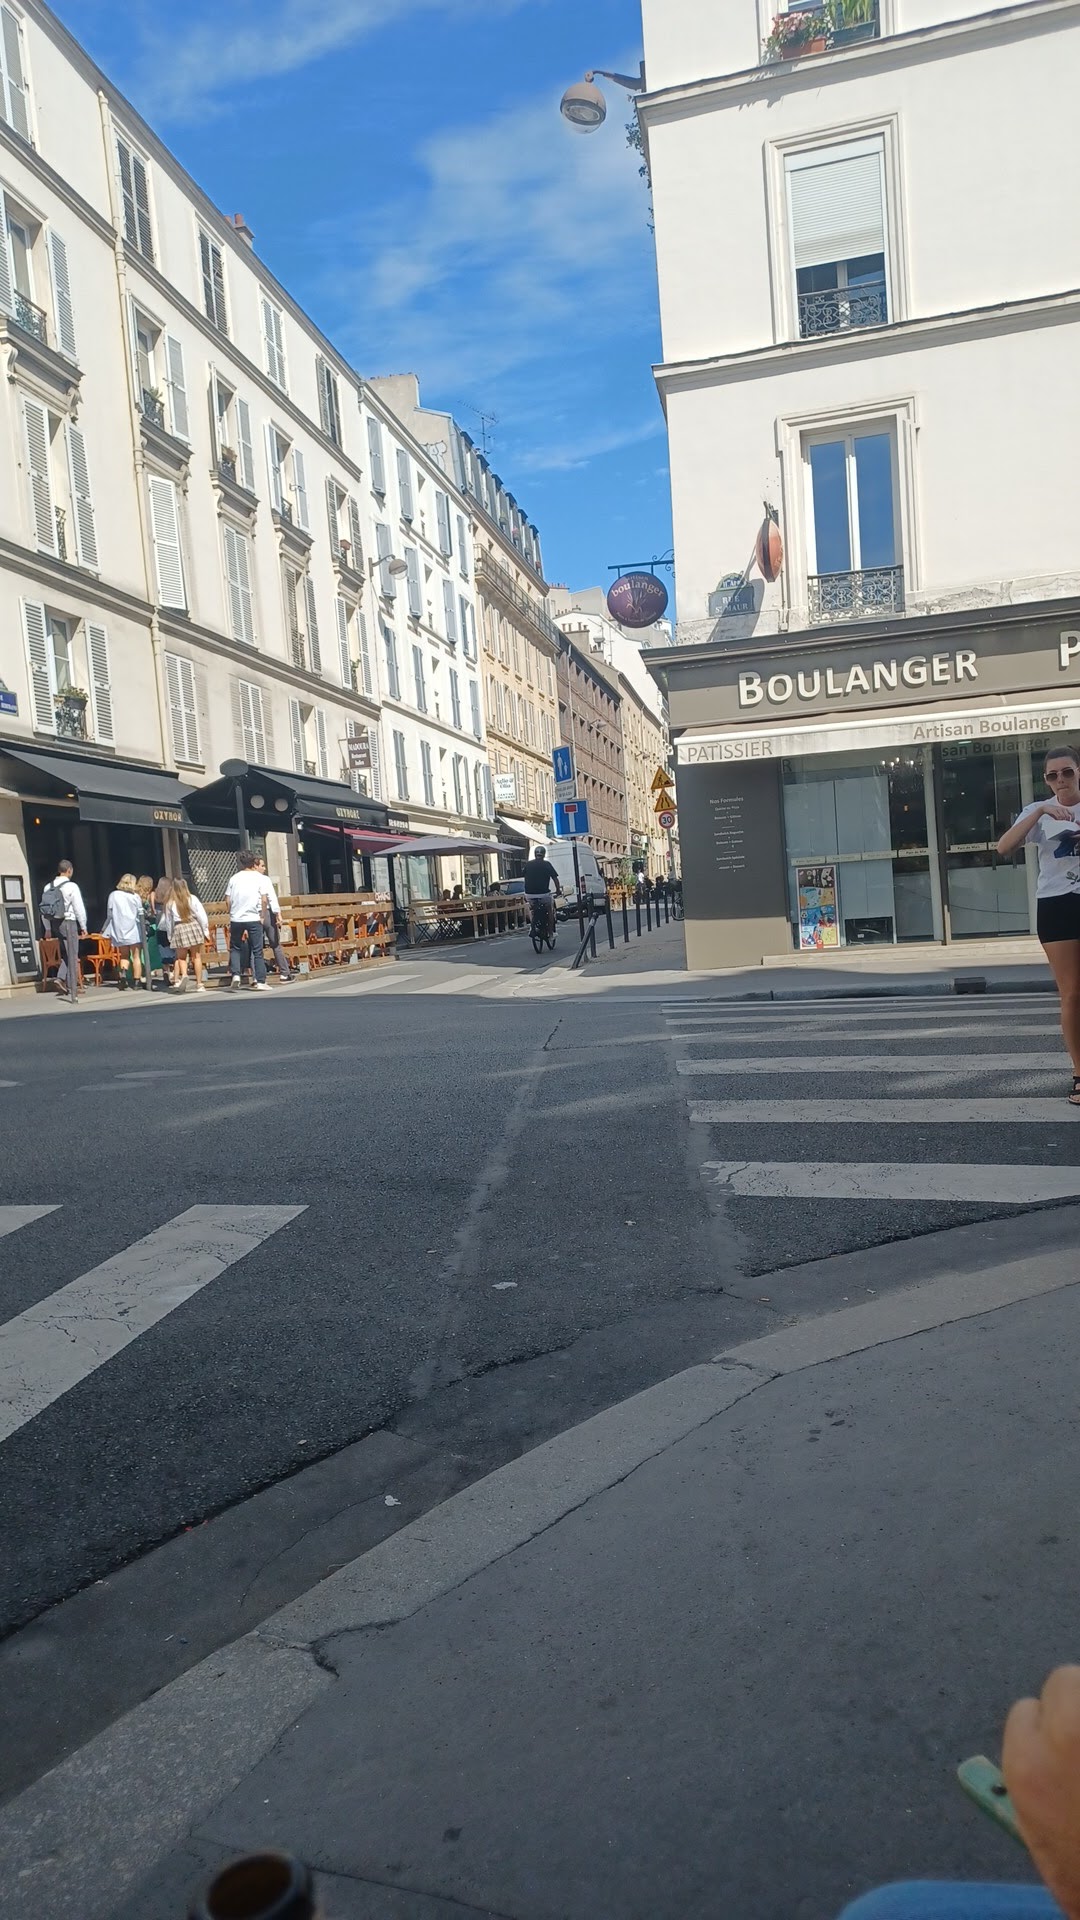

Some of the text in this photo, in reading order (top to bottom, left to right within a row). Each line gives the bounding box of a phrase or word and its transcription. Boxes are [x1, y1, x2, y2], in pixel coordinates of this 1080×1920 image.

[611, 579, 664, 597] boulanger
[722, 595, 740, 604] RUE
[738, 649, 979, 707] BOULANGER
[913, 714, 1069, 740] Artisan Boulanger
[662, 815, 672, 825] 30
